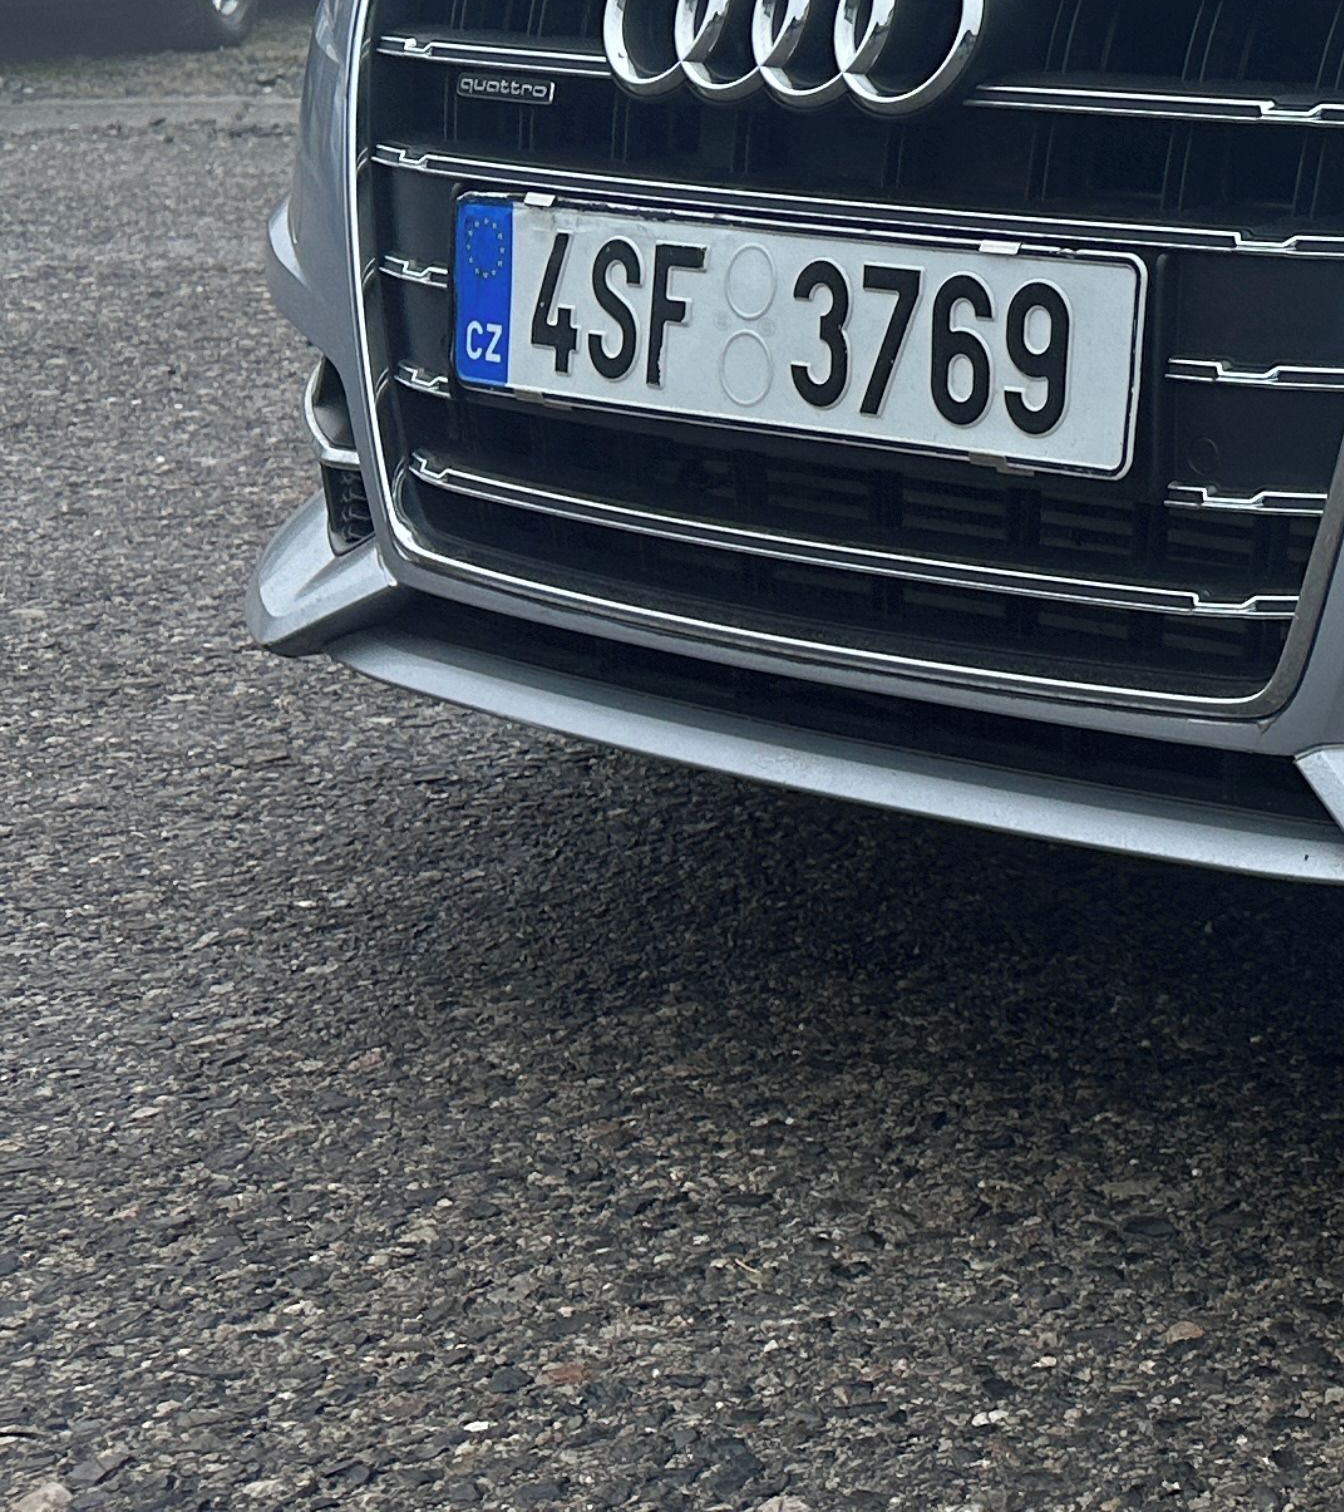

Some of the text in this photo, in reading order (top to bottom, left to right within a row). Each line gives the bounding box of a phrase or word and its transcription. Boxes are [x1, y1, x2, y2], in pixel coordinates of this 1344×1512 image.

[460, 77, 548, 99] quattro
[465, 321, 502, 363] CZ
[530, 232, 1070, 436] 4SF 3769
